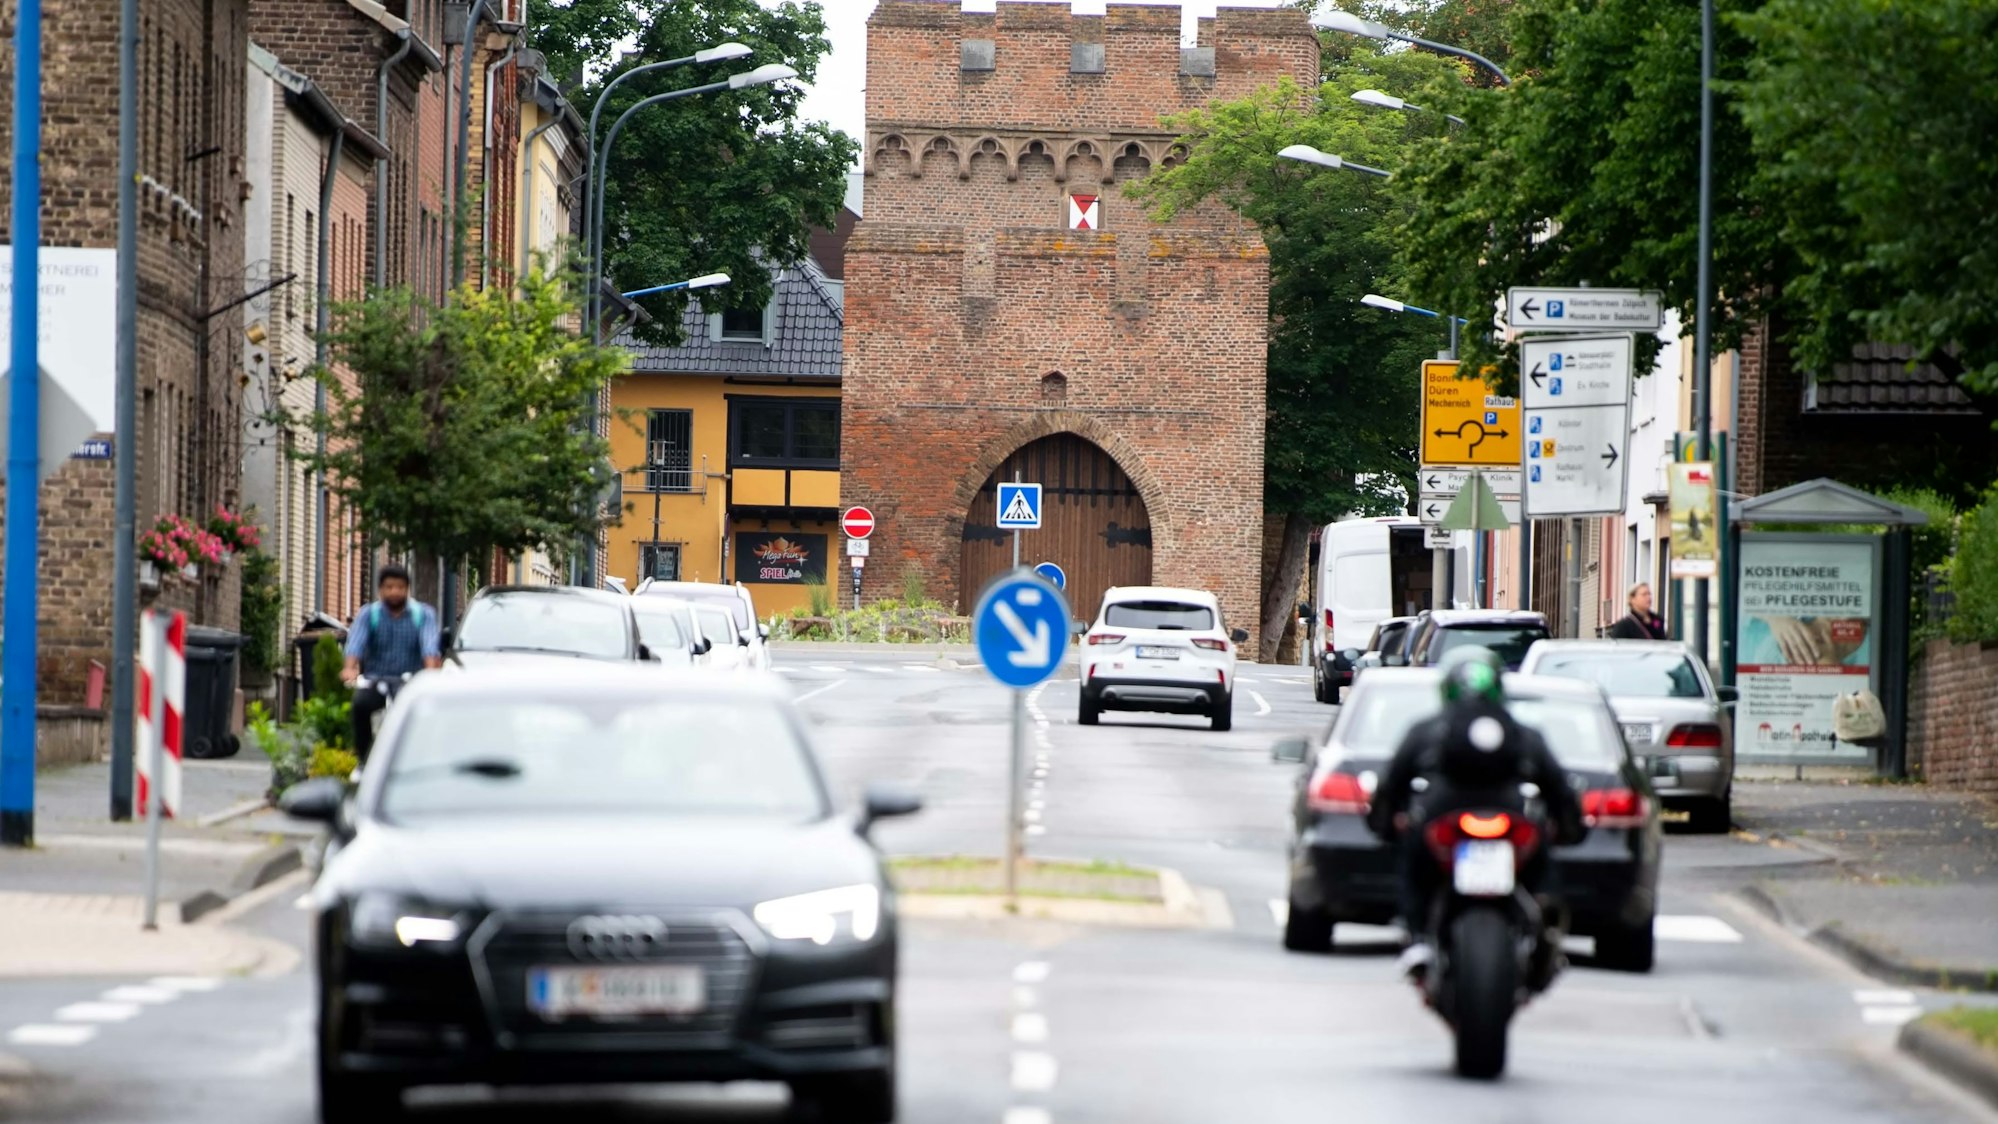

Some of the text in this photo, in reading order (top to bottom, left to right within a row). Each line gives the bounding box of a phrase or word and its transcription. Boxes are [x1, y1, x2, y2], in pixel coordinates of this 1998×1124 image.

[1569, 313, 1650, 321] Museum der Badekultur
[1429, 385, 1459, 395] Düren
[1429, 399, 1471, 408] Mechernich
[1486, 397, 1514, 406] Rathaus
[782, 549, 798, 559] Fun
[760, 567, 786, 579] SPIEL
[1745, 566, 1840, 578] KOSTENFREIE
[1744, 581, 1862, 592] PFLEGEHILFSMITTEL
[1765, 594, 1863, 607] PFLEGESTUFE
